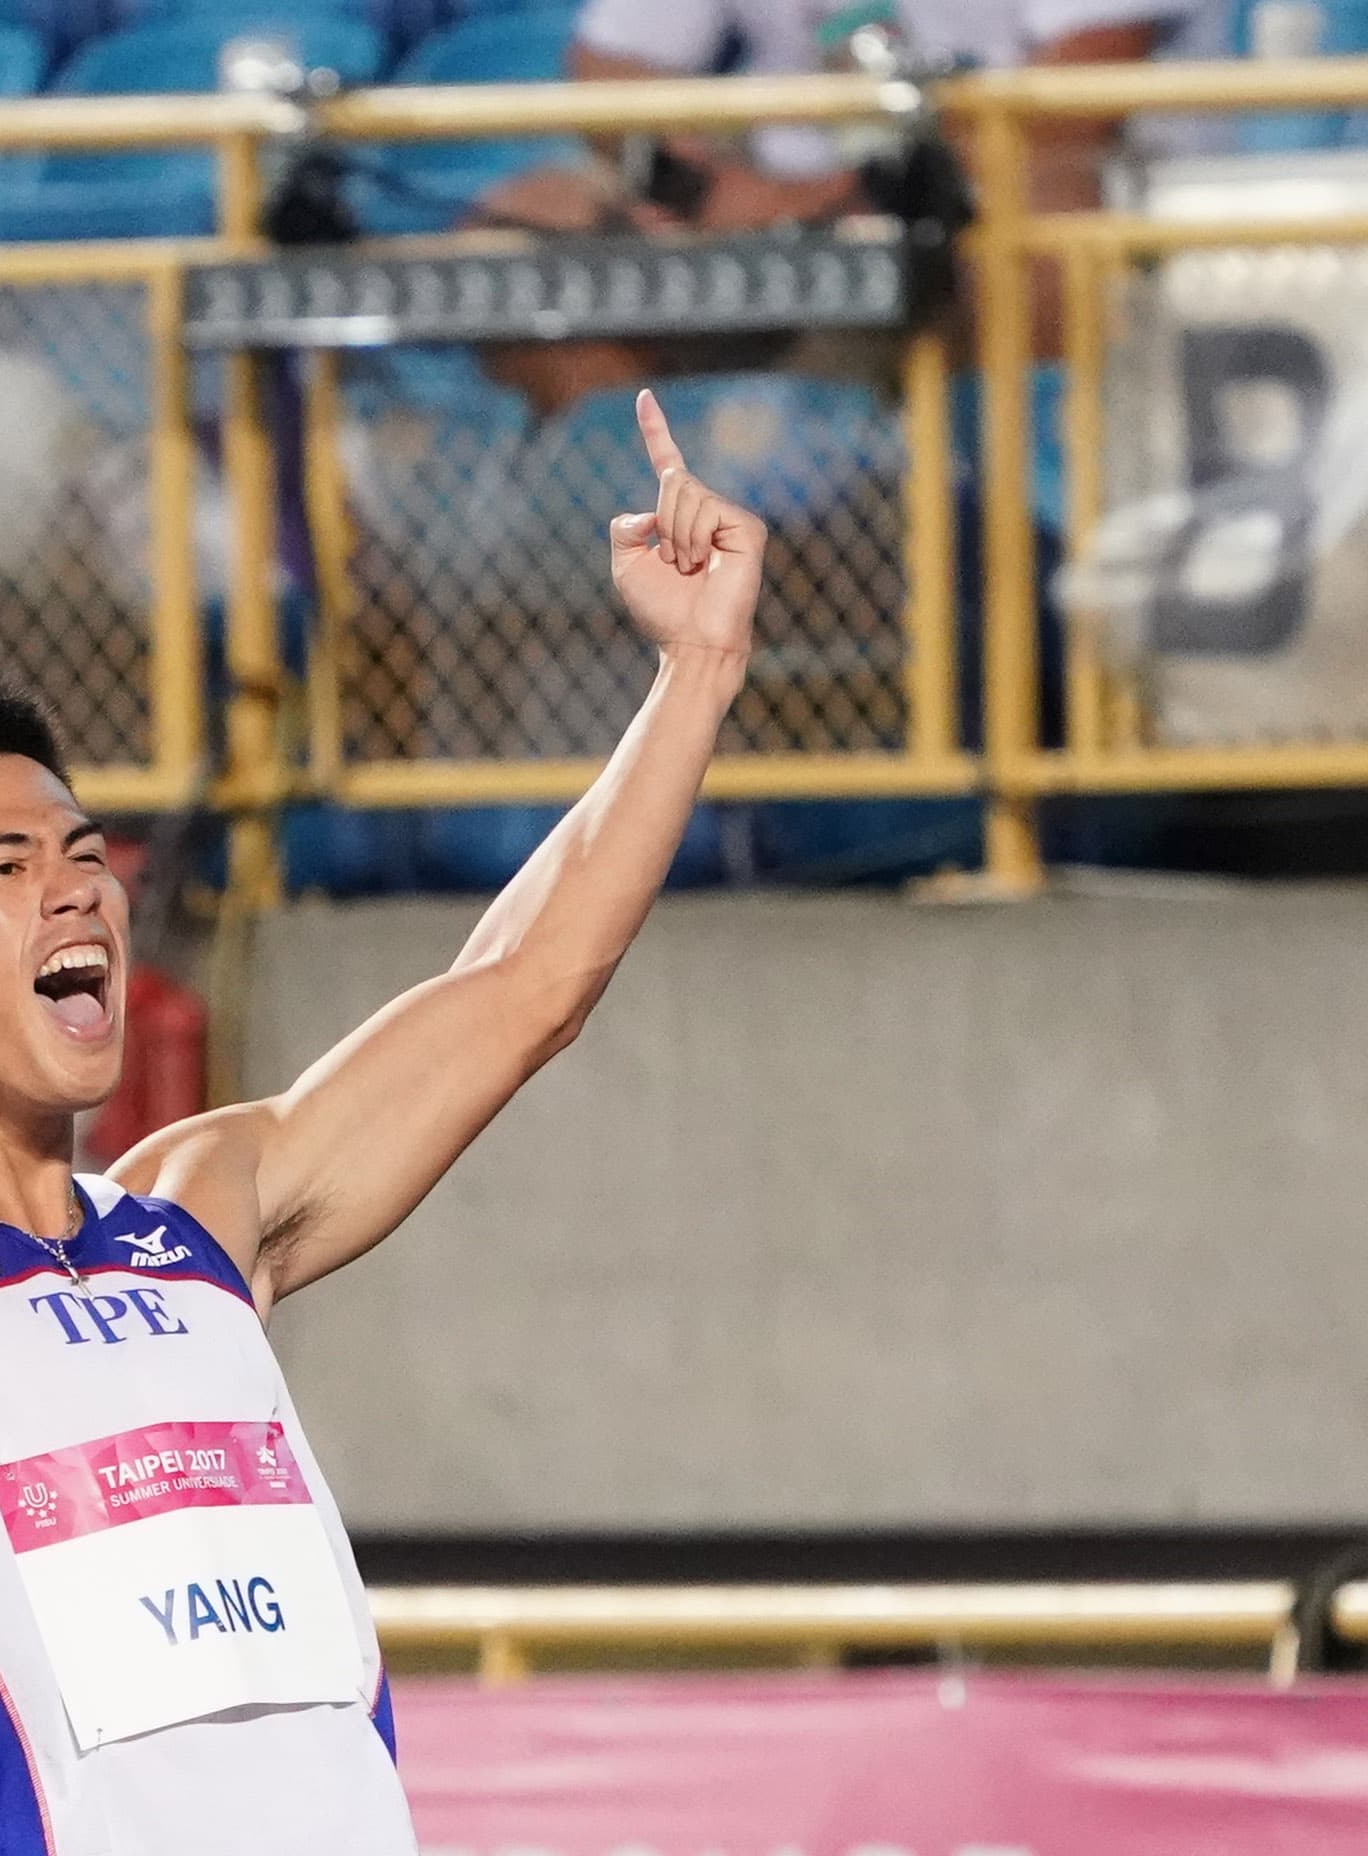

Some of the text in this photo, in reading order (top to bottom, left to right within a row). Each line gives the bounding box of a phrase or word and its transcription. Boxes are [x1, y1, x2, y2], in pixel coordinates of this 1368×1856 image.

[130, 1245, 192, 1267] MIZUN
[28, 1288, 189, 1344] TPE
[98, 1448, 225, 1489] TAIPEI 2017
[110, 1475, 239, 1507] SUMMER UNIVERSIADE
[138, 1576, 285, 1646] YANG
